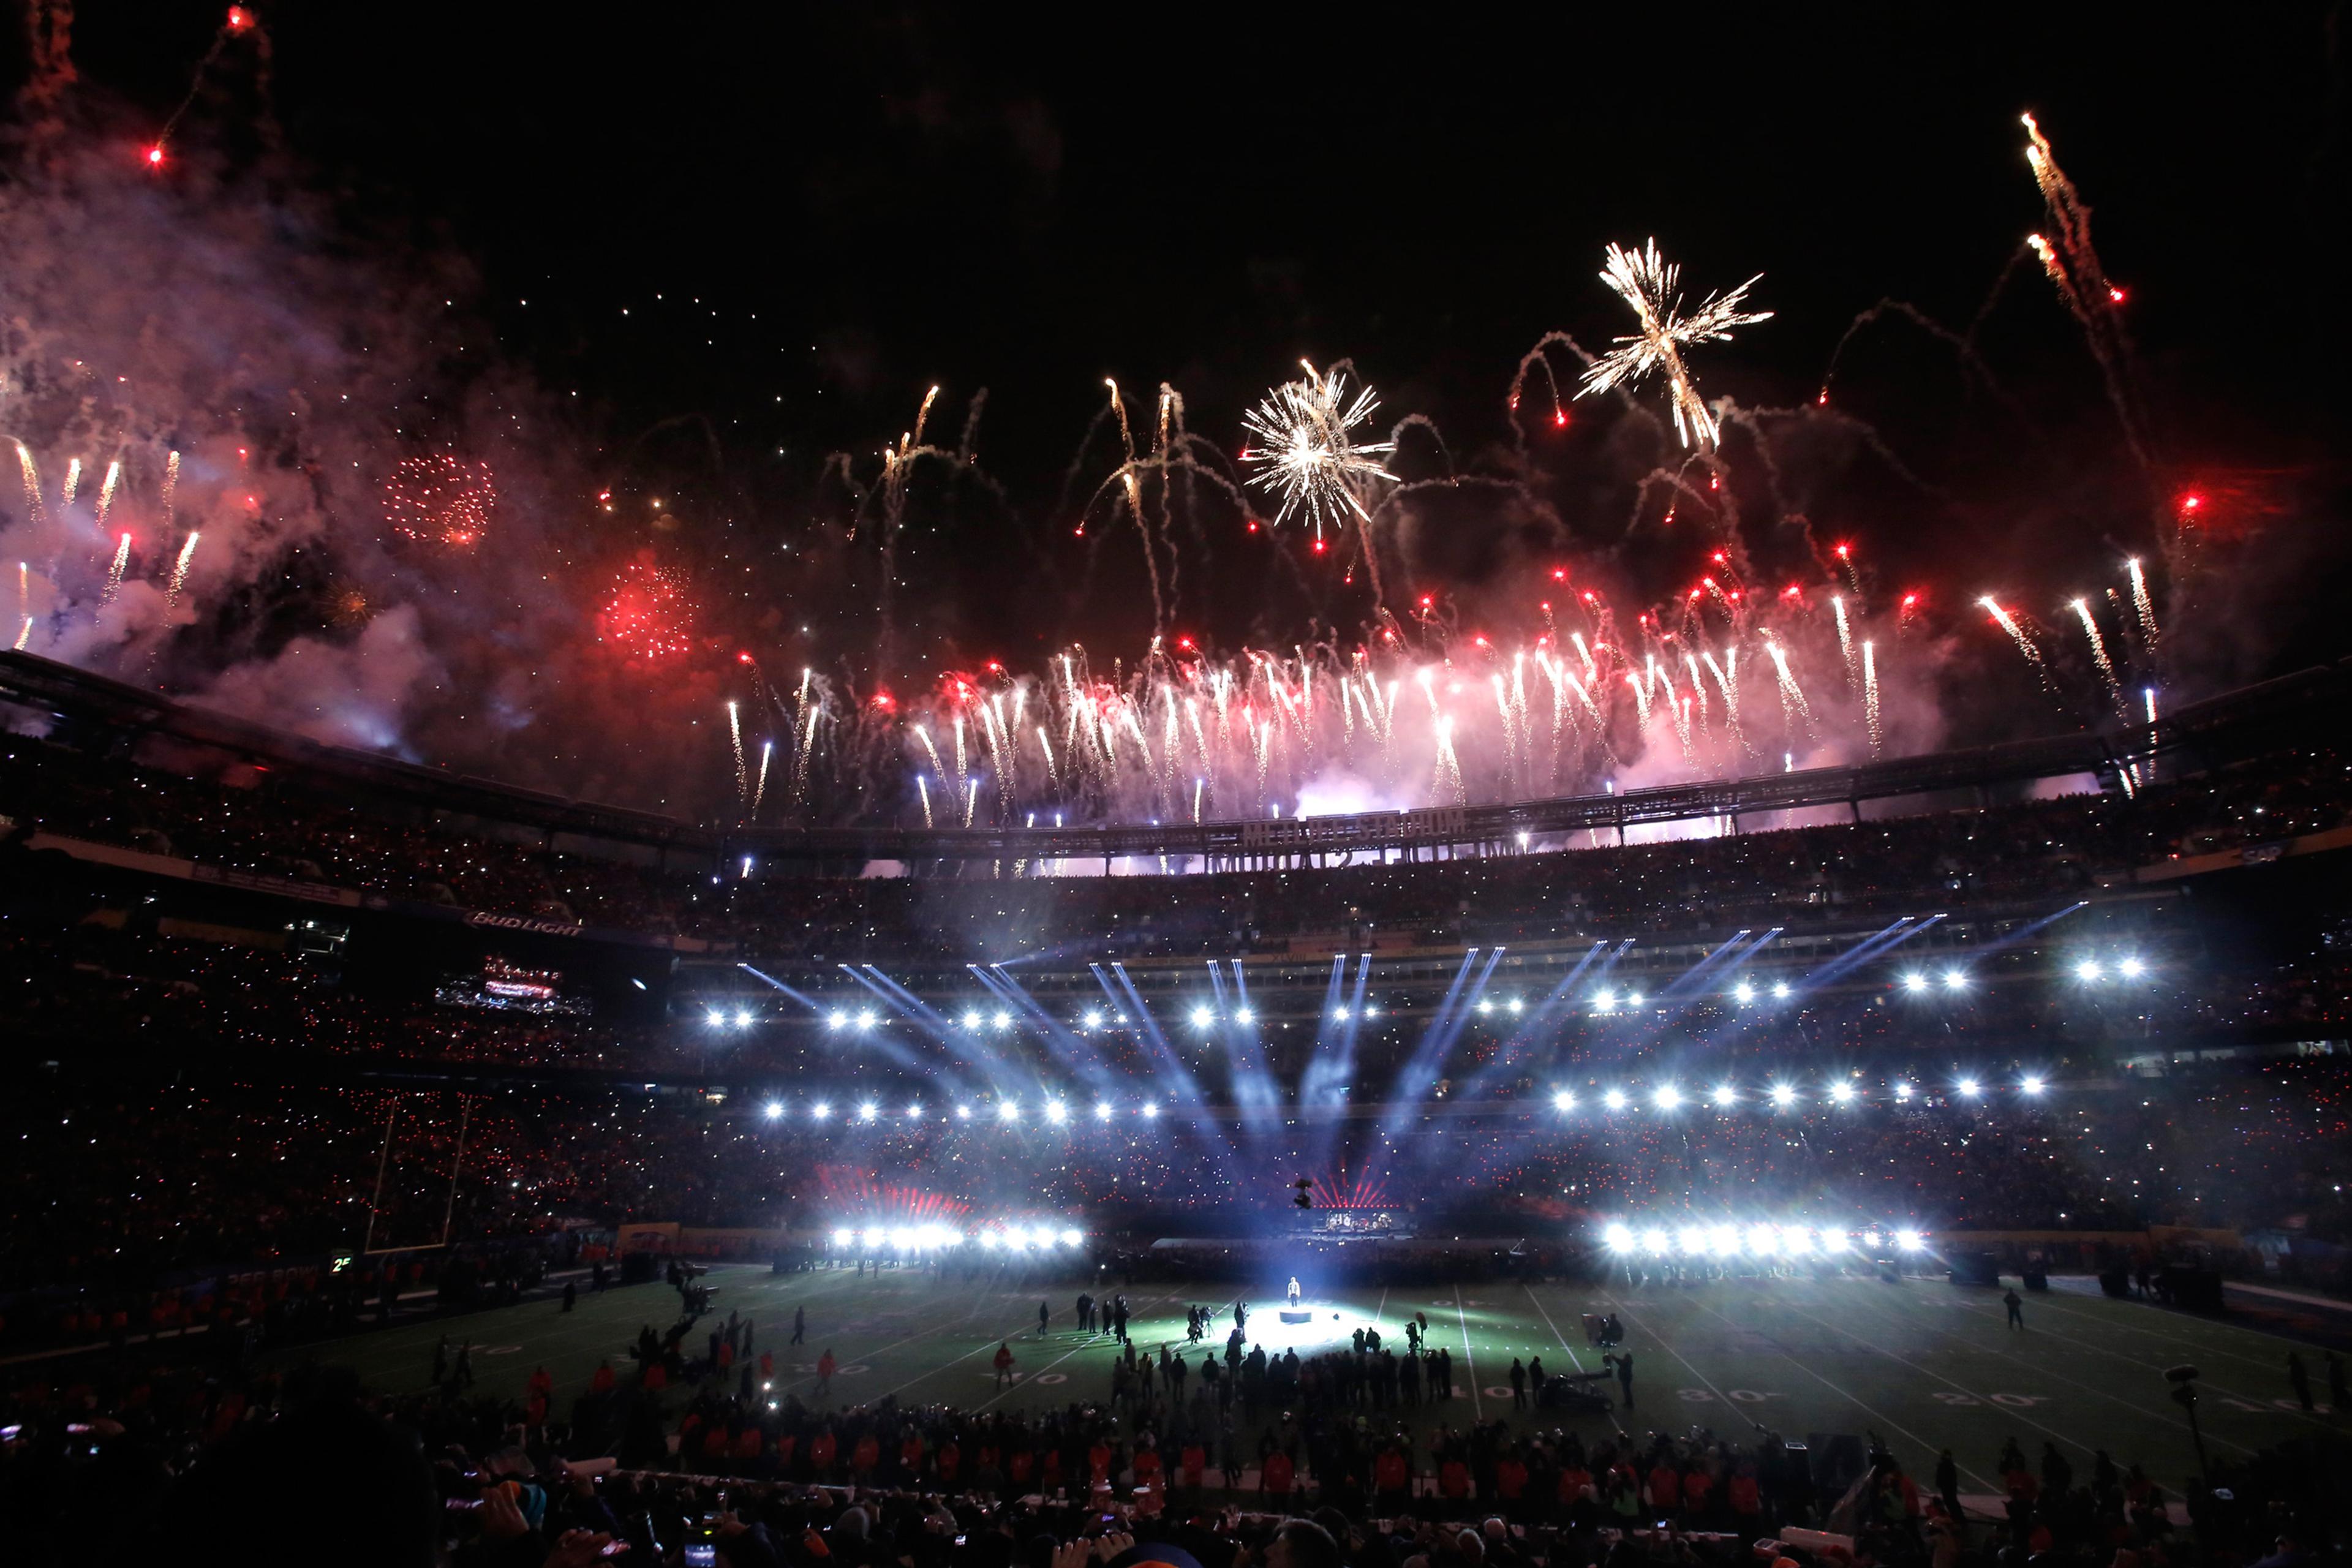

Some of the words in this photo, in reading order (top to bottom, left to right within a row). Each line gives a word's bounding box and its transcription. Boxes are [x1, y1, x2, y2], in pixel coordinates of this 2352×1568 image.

[1243, 817, 1344, 848] METLIFE
[1356, 809, 1466, 842] STADIUM
[472, 911, 521, 929] BUD
[521, 919, 585, 937] LIGHT
